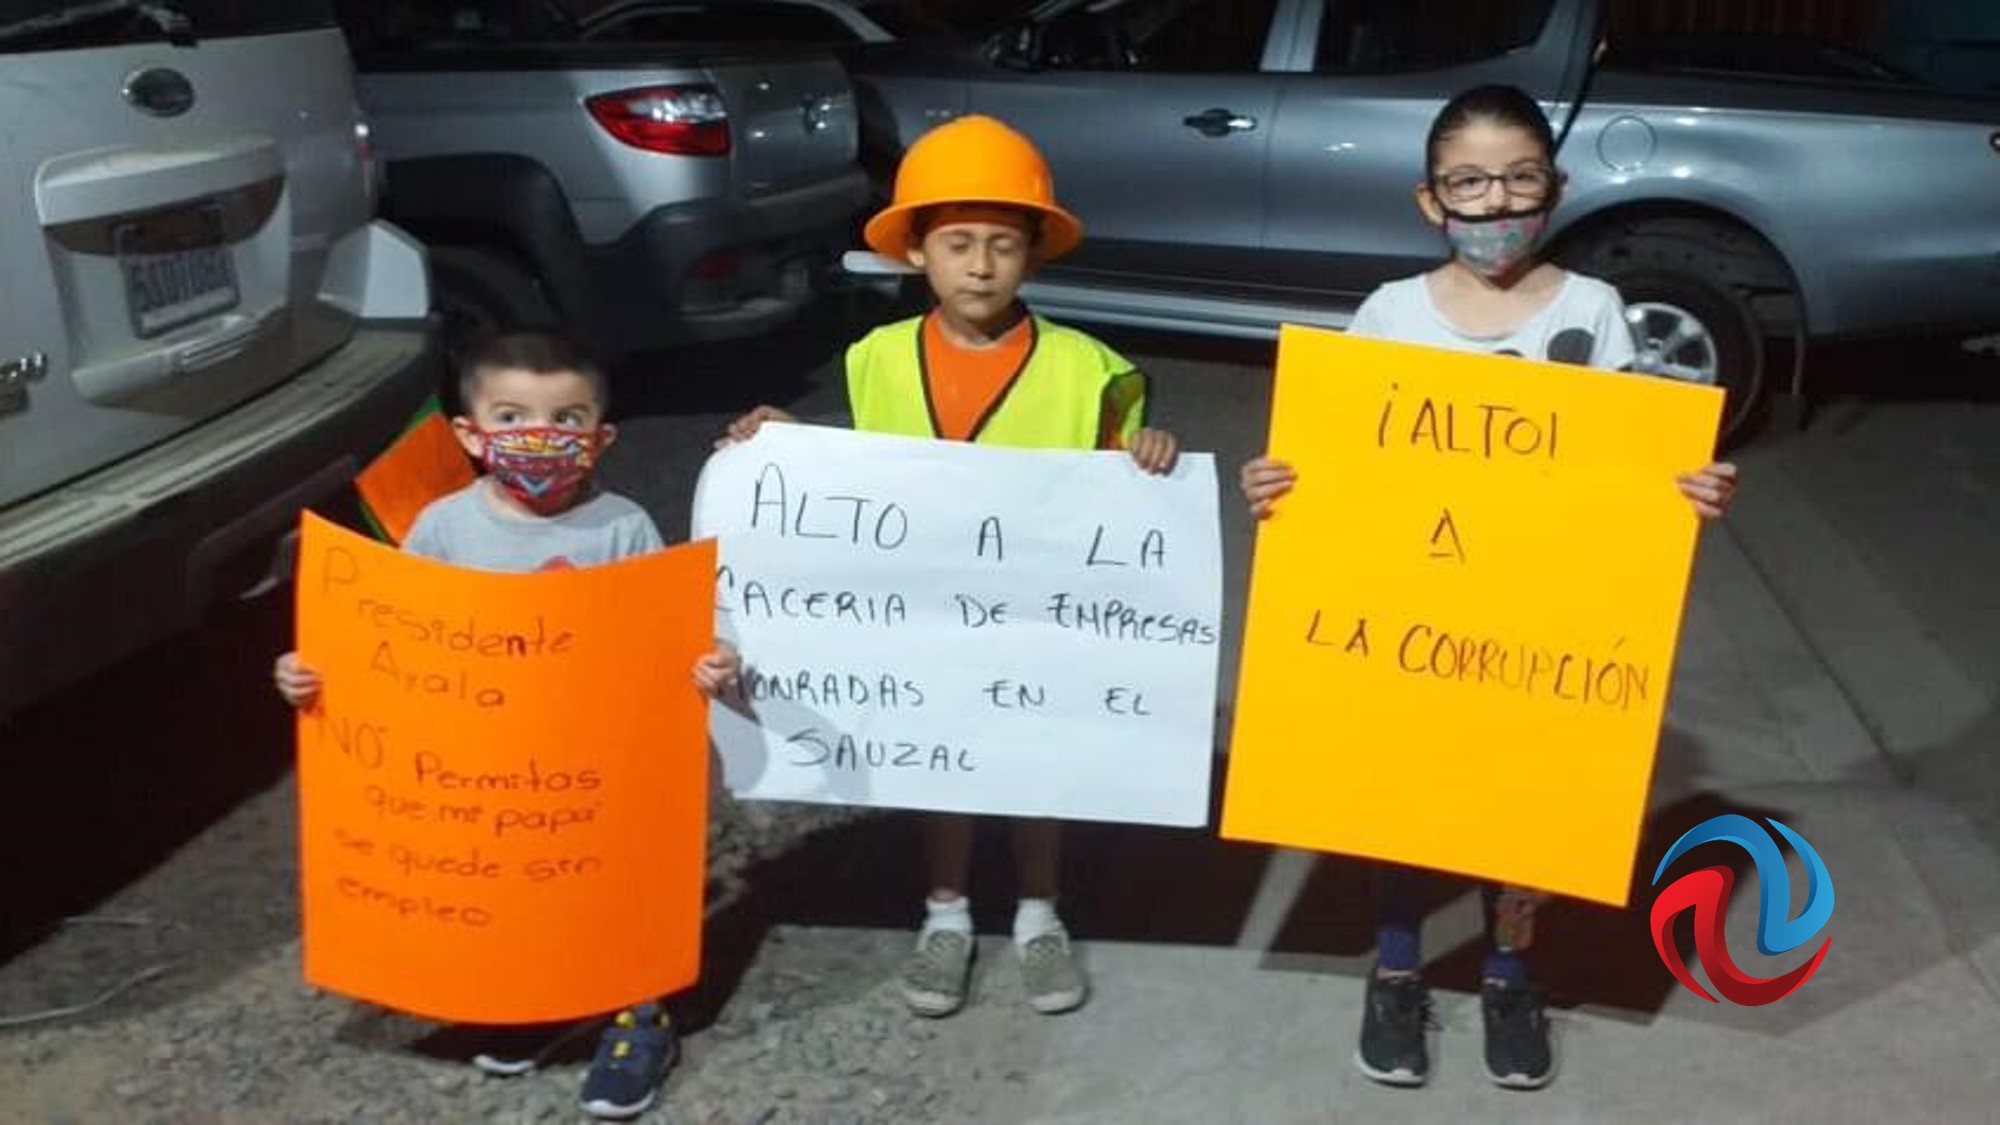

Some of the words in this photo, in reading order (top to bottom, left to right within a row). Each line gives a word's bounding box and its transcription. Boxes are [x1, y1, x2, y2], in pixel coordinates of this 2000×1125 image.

[750, 462, 908, 550] ALTO
[976, 515, 1003, 562] A
[1085, 524, 1168, 568] LA
[1428, 507, 1466, 564] A
[321, 545, 574, 659] Presidente
[955, 592, 1008, 628] DE
[1046, 592, 1217, 646] EMPRESAS
[1306, 608, 1370, 657] LA
[1398, 623, 1650, 712] CORRUPCIÓN
[983, 679, 1045, 710] EN
[1104, 685, 1153, 717] EL
[786, 728, 981, 772] SAUZAL
[336, 876, 494, 928] empleo
